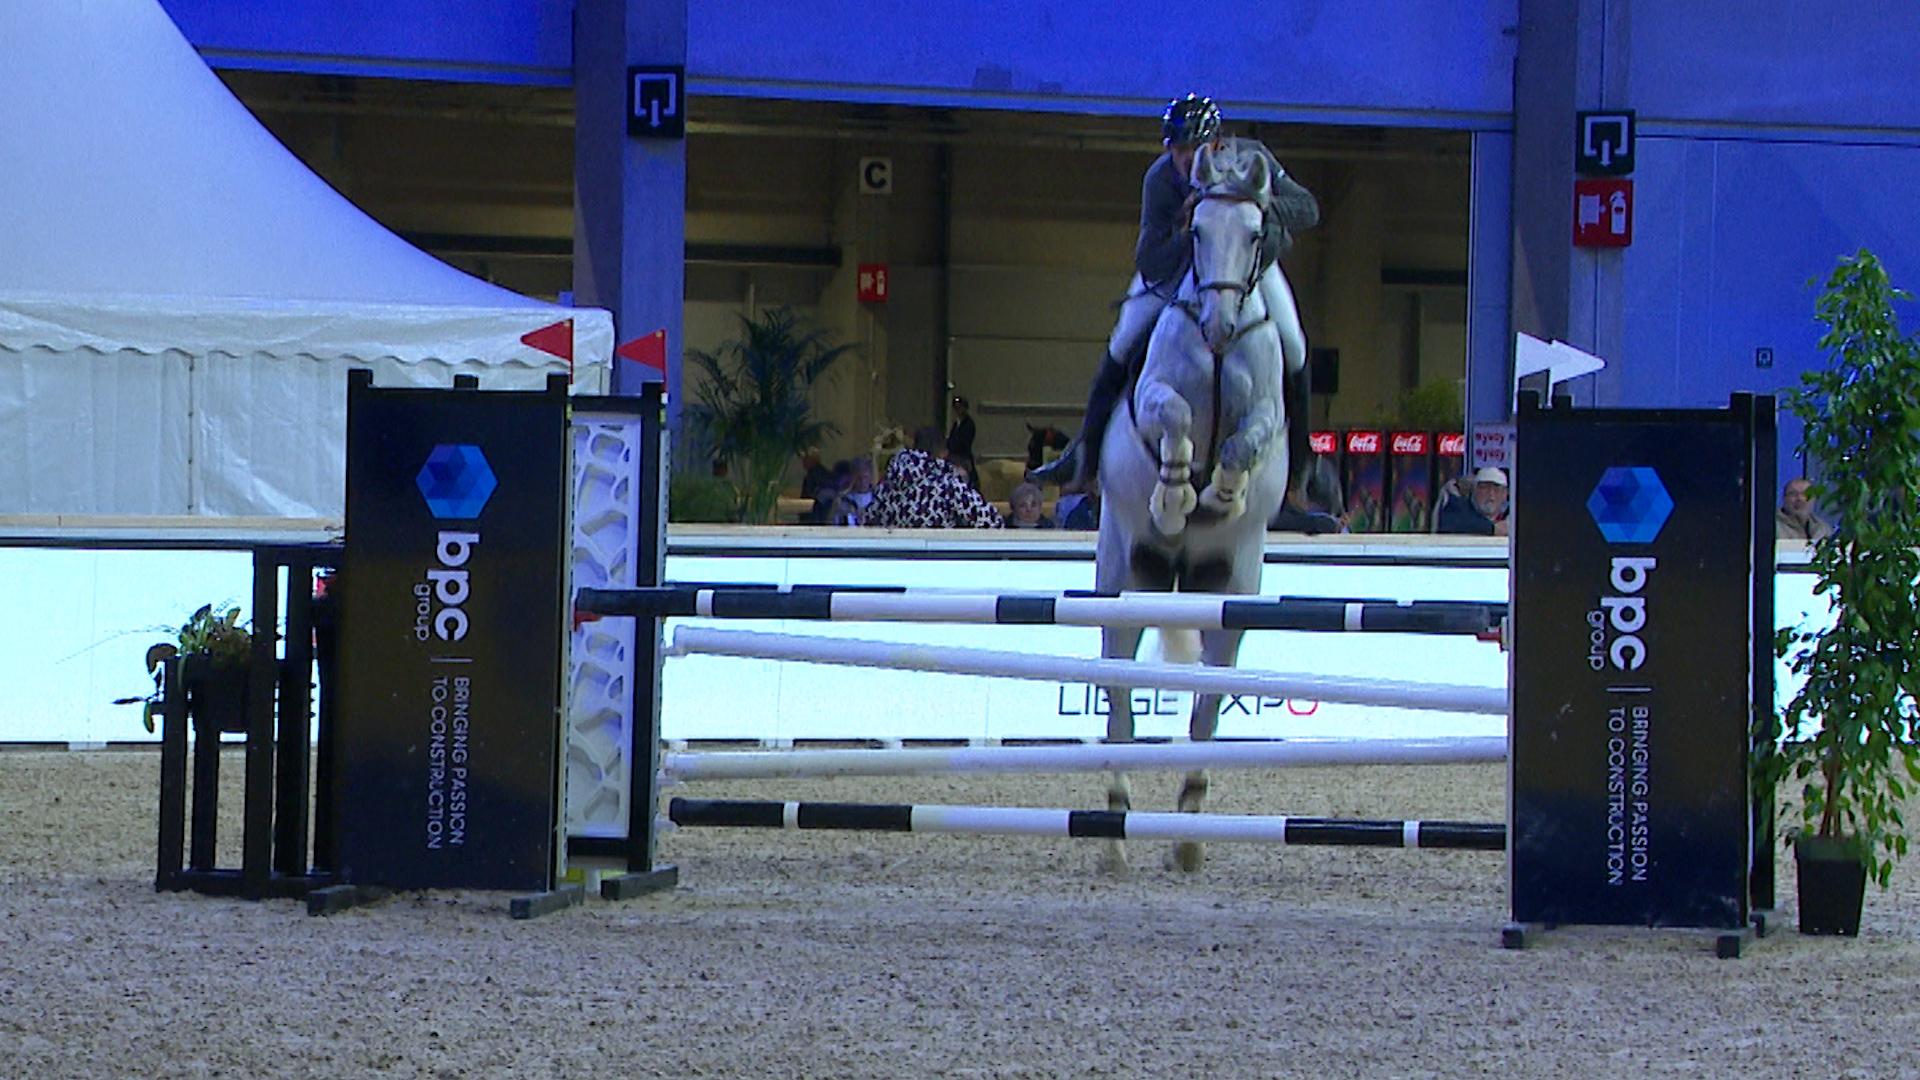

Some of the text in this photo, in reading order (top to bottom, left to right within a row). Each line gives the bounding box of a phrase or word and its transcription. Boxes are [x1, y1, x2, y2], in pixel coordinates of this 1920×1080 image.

[864, 160, 887, 189] C
[413, 583, 431, 641] group
[427, 531, 480, 641] bpc
[1586, 610, 1605, 670] group
[1600, 557, 1657, 671] bpc
[1194, 691, 1318, 715] XPO
[427, 676, 448, 849] TO CONSTRUCTION
[449, 677, 470, 845] BRINGING PASSION
[1607, 706, 1625, 886] TO CONSTRUCTION
[1630, 706, 1649, 882] BRINGING PASSION
